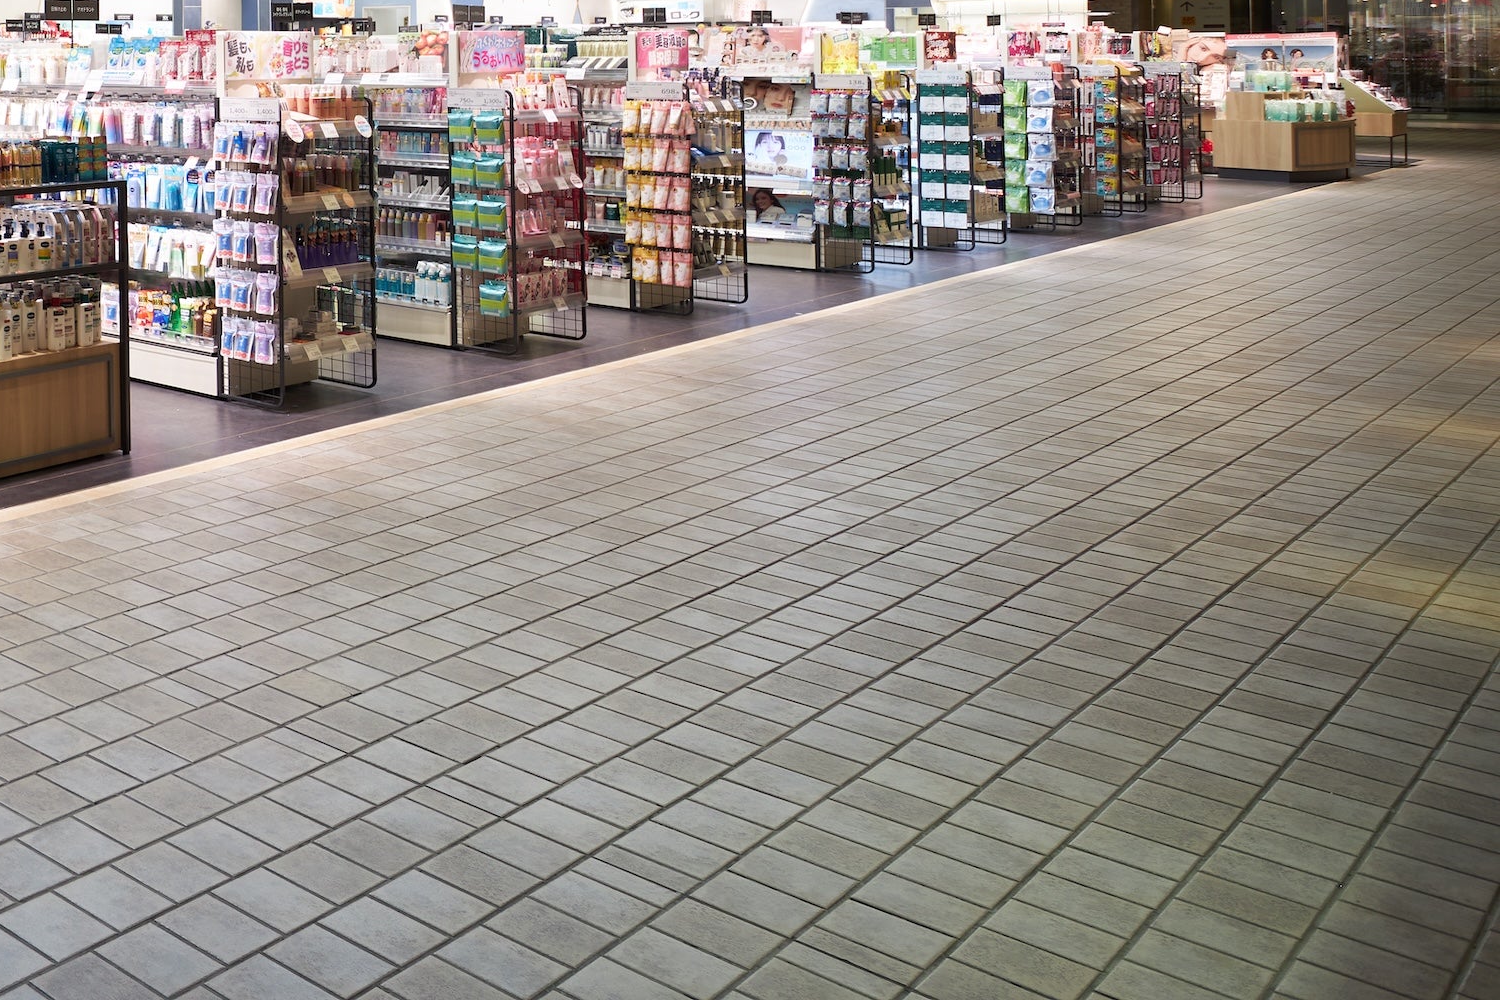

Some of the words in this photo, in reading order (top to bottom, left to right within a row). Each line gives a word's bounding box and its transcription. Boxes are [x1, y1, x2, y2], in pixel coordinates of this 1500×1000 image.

[235, 56, 254, 74] 私も
[285, 57, 310, 75] まとう
